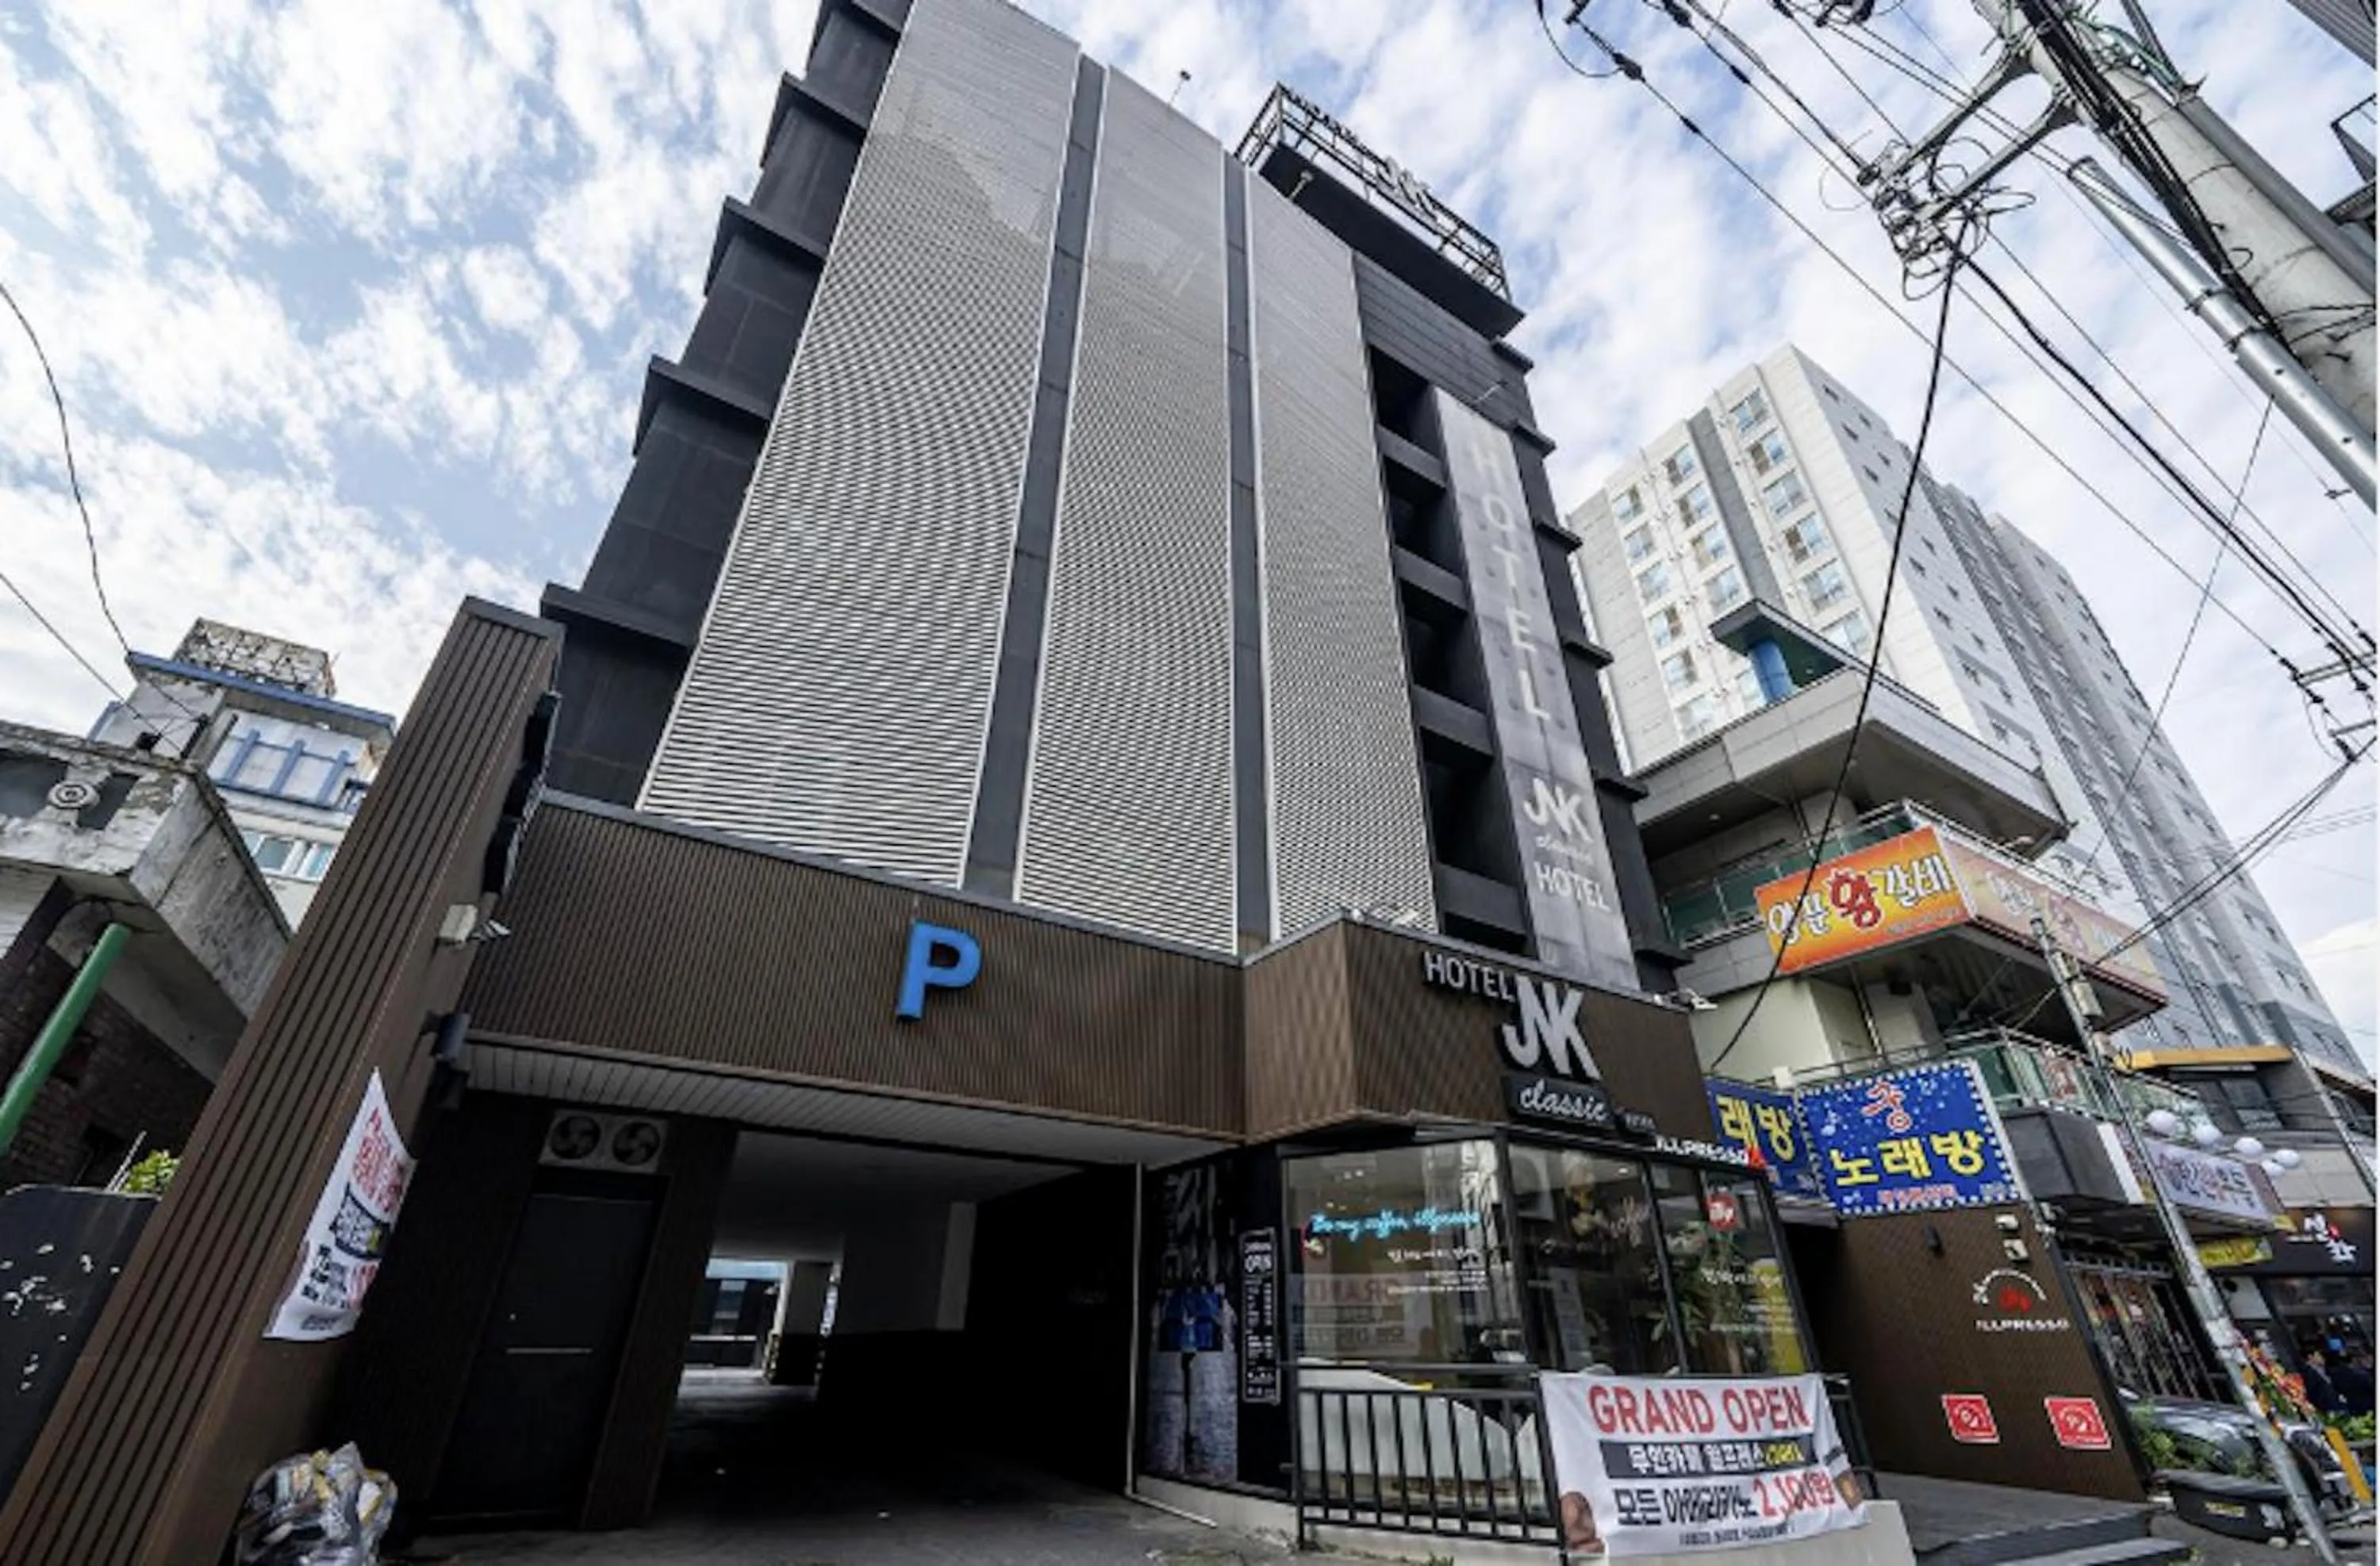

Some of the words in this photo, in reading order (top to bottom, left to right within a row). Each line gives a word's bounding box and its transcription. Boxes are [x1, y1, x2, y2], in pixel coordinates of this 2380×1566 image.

[1471, 436, 1550, 721] HOTEL
[1523, 777, 1594, 843] JNK
[1534, 861, 1612, 912] HOTEL
[896, 921, 982, 1019] P
[1424, 951, 1514, 1002] HOTEL
[1501, 975, 1602, 1080] JNK
[1520, 1078, 1608, 1123] classic
[1829, 1130, 1985, 1186] 노래방
[1588, 1384, 1714, 1434] GRAND
[1722, 1385, 1810, 1434] OPEN
[1613, 1487, 1662, 1526] 모든
